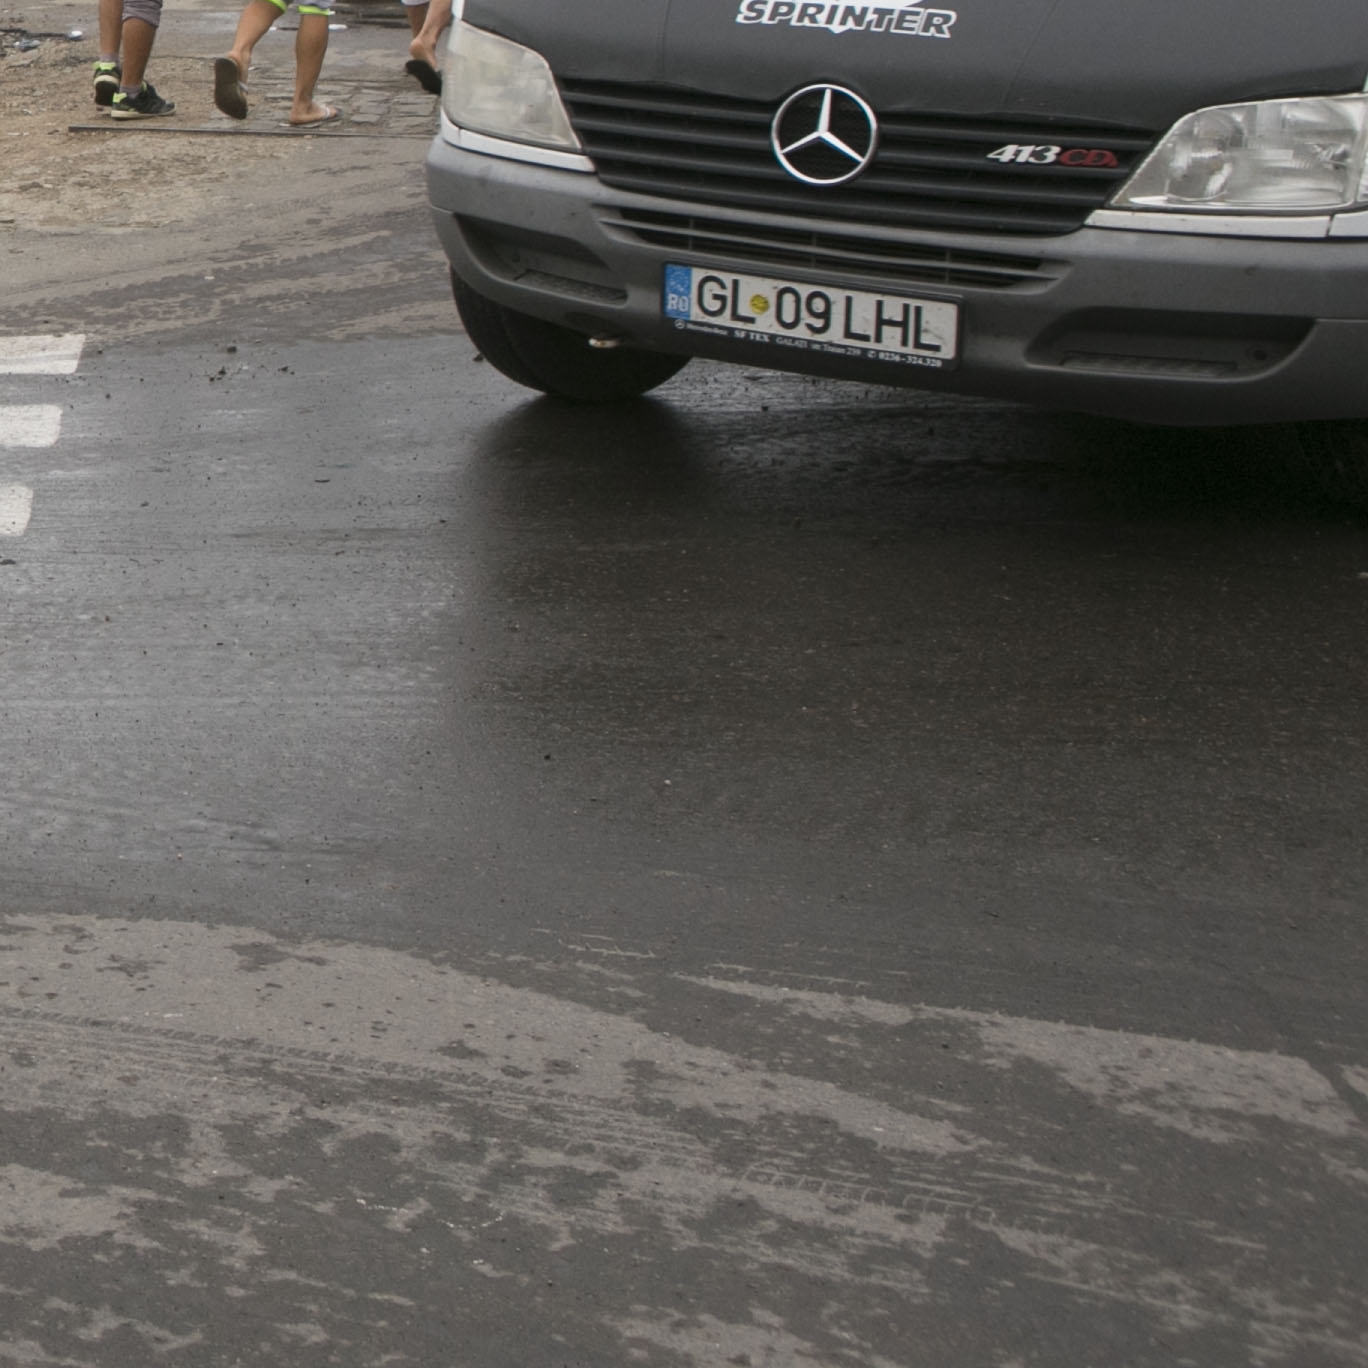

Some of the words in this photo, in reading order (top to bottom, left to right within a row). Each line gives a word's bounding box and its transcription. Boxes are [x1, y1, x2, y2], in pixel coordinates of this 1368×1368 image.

[667, 292, 689, 312] RO
[697, 275, 757, 325] GL
[775, 286, 832, 334] 09
[843, 295, 942, 352] LHL
